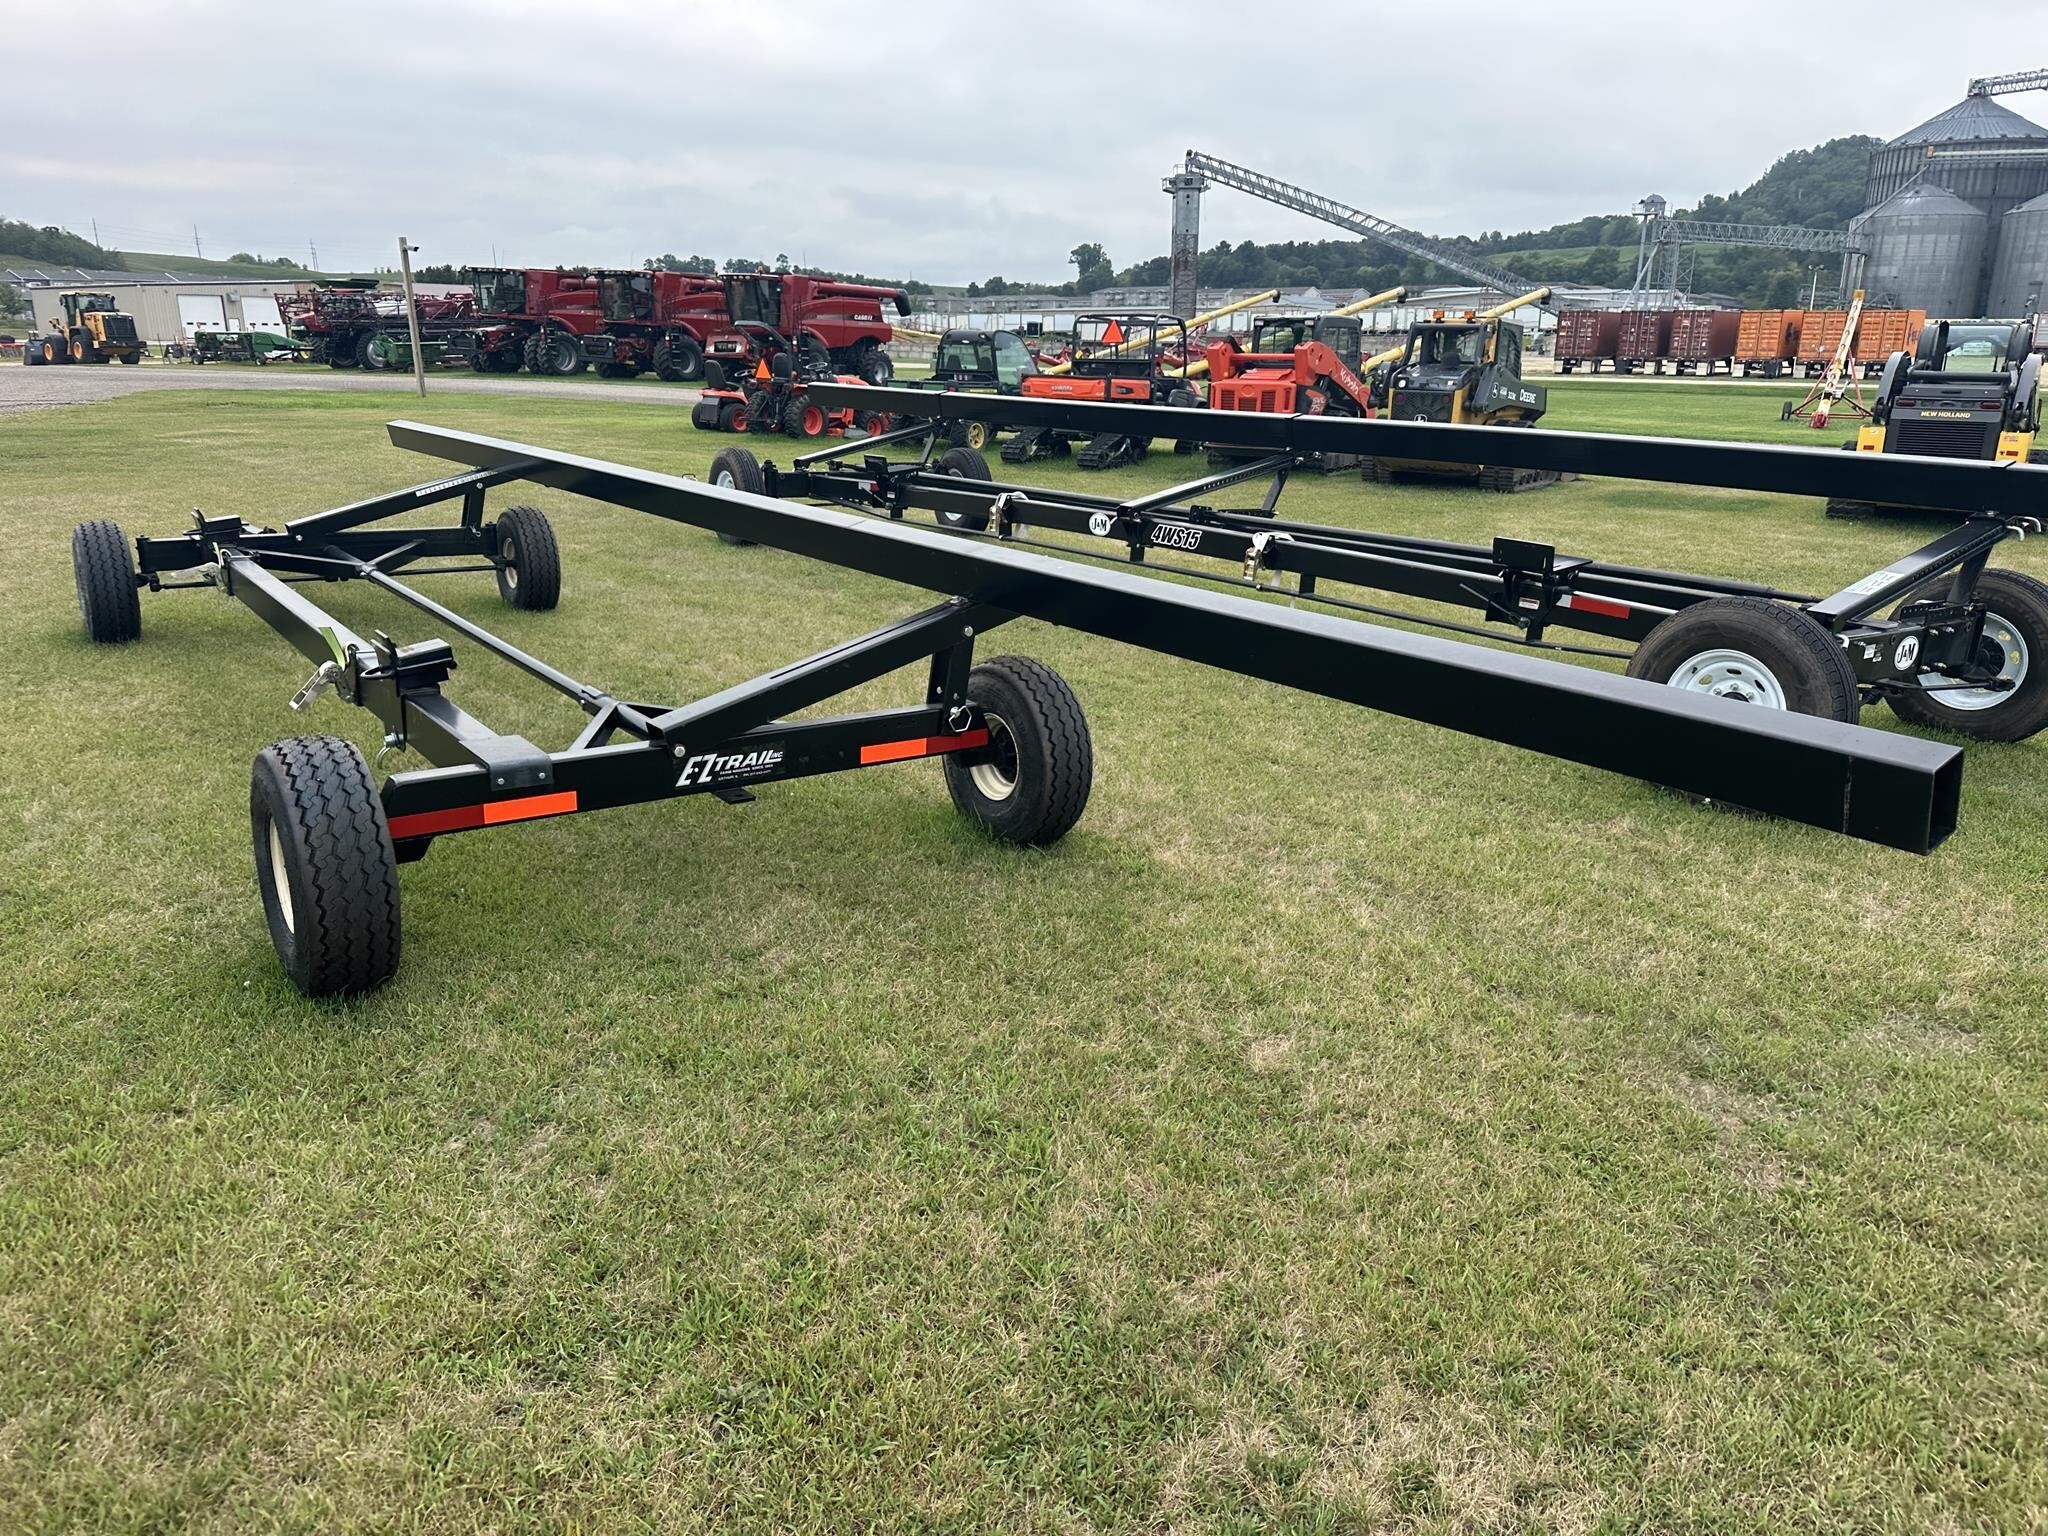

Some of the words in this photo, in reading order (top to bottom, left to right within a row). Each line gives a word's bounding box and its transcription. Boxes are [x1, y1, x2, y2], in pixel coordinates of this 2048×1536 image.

[1519, 388, 1537, 404] DEERE
[1938, 411, 1971, 419] HOLLAND
[1151, 523, 1203, 550] 4WS15
[1897, 642, 1917, 664] J&M
[714, 749, 782, 772] TRAIL
